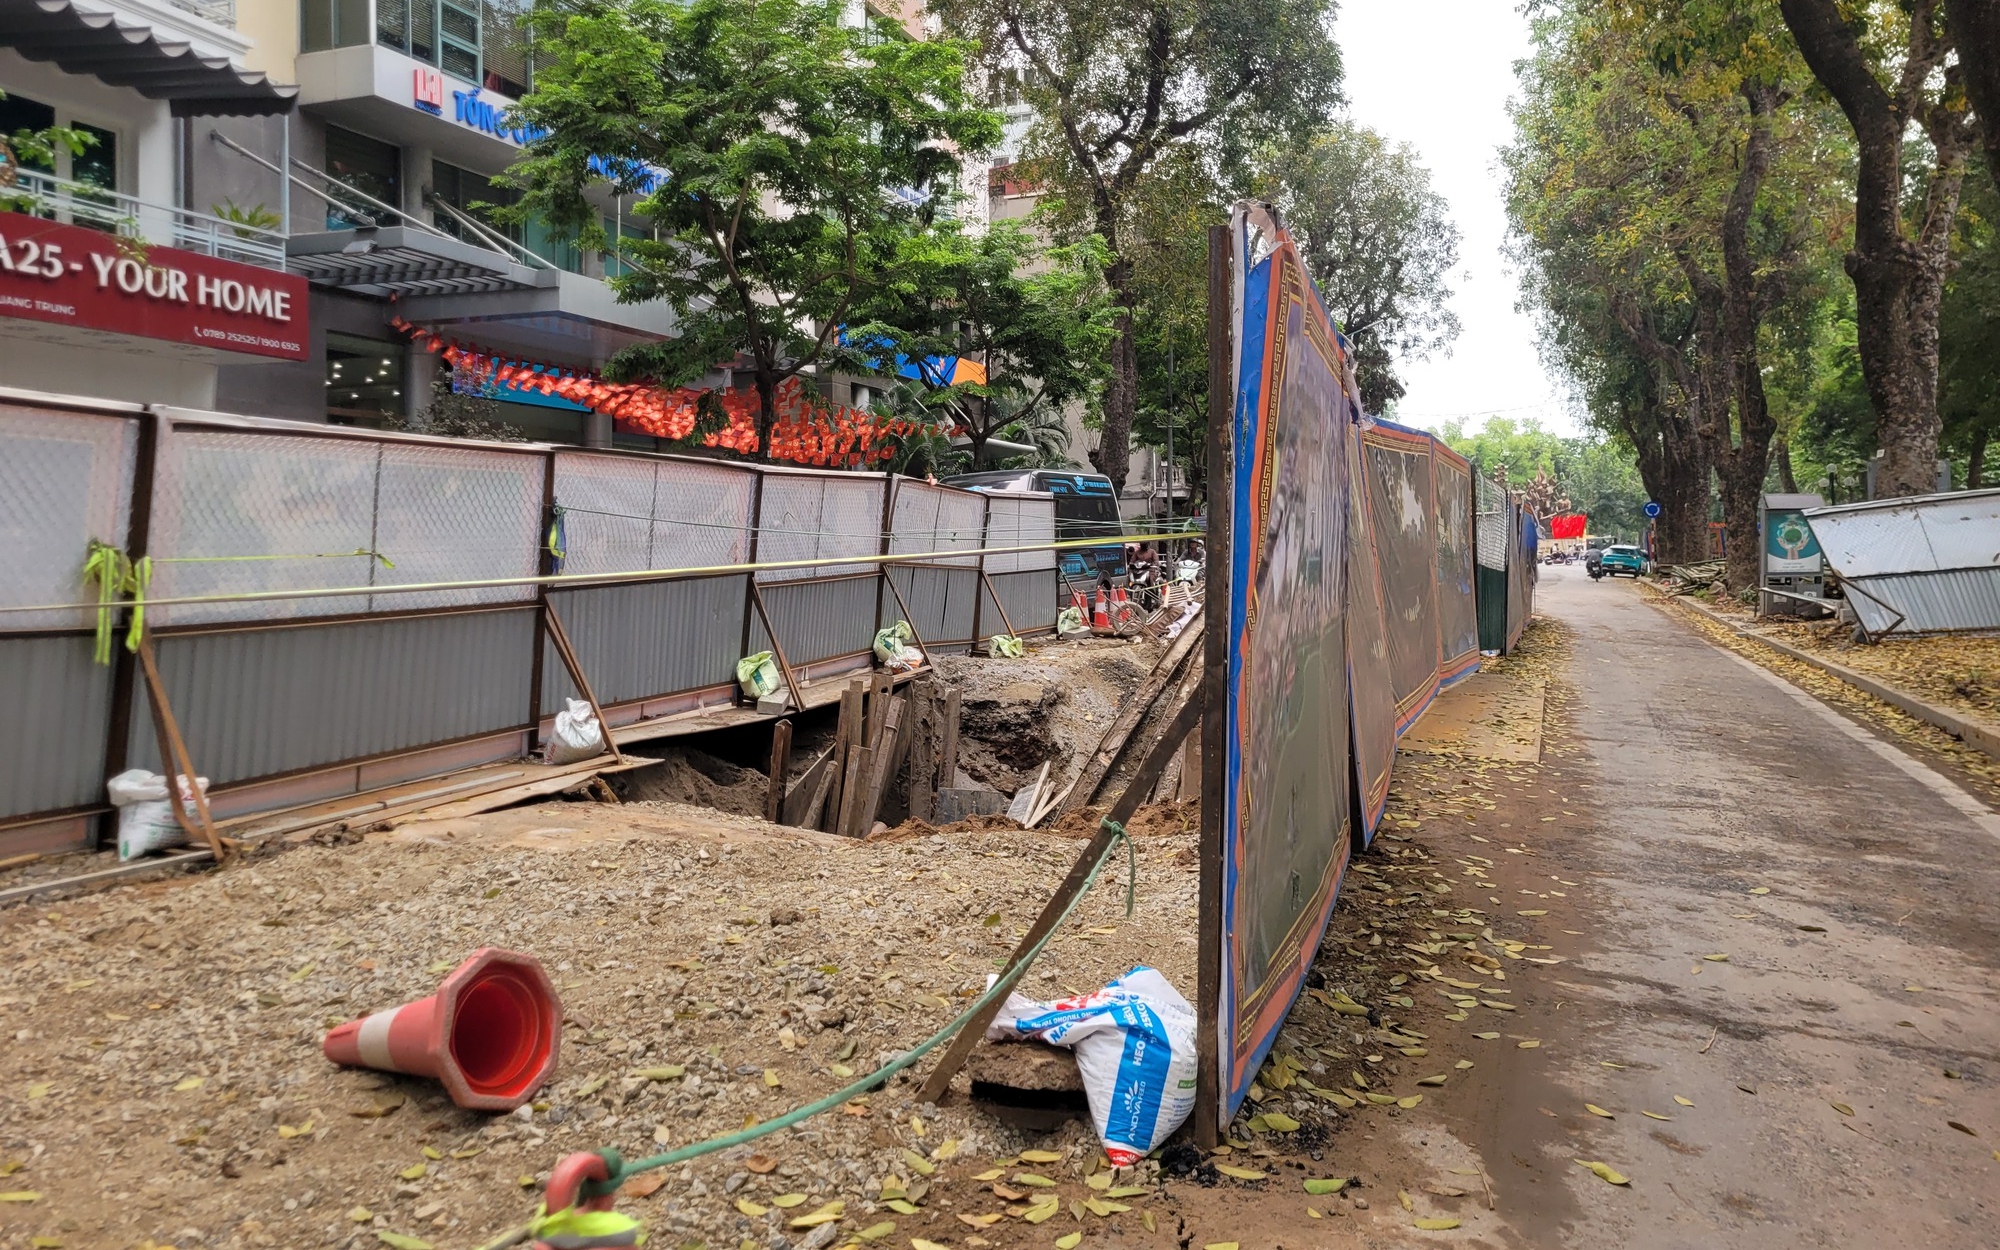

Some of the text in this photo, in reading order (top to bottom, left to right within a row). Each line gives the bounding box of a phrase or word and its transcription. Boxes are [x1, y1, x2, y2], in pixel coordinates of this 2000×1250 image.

[89, 251, 190, 303] YOUR
[197, 273, 292, 322] HOME
[35, 300, 76, 316] TRUNG
[202, 328, 226, 340] 0789
[280, 341, 301, 352] 6925
[1132, 1040, 1146, 1067] HEO
